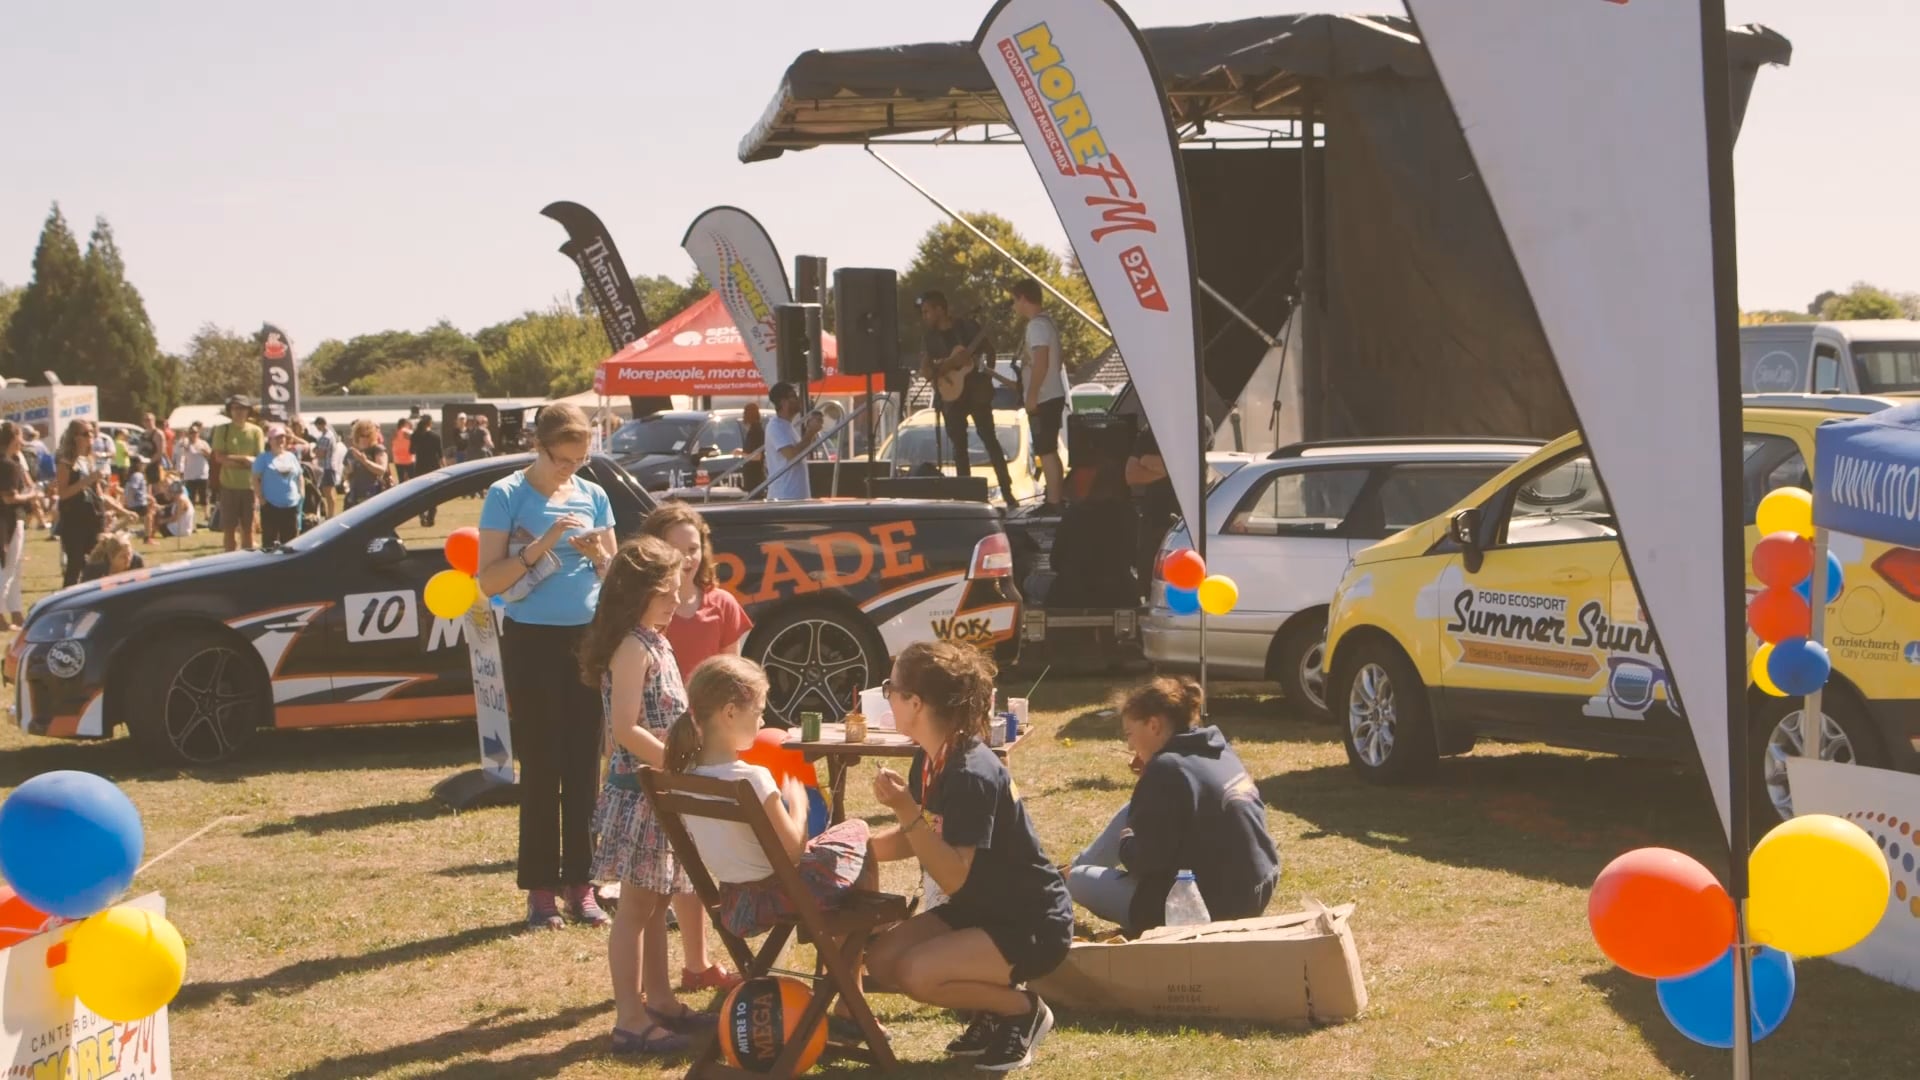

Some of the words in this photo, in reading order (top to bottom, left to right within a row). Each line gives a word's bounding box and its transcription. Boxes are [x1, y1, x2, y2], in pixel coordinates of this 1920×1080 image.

[1002, 43, 1030, 92] TODAY'S
[1024, 86, 1044, 116] BEST
[1037, 112, 1061, 151] MUSIC
[1053, 146, 1071, 173] MIX
[1013, 20, 1110, 167] MORE
[1077, 153, 1158, 244] FM
[1123, 251, 1158, 300] 92.1
[618, 367, 655, 380] More
[655, 366, 705, 381] people,
[708, 367, 745, 379] more
[1831, 454, 1920, 522] www.mo
[714, 521, 925, 605] RADE
[358, 595, 405, 637] 10
[1447, 589, 1565, 645] Summer
[1478, 591, 1506, 606] FORD
[1508, 594, 1567, 612] ECOSPORT
[1832, 636, 1900, 650] Christchurch
[1841, 648, 1859, 661] City
[1860, 649, 1899, 662] Council
[736, 1001, 747, 1016] 10
[752, 992, 776, 1061] MEGA
[736, 1018, 750, 1054] MITRE
